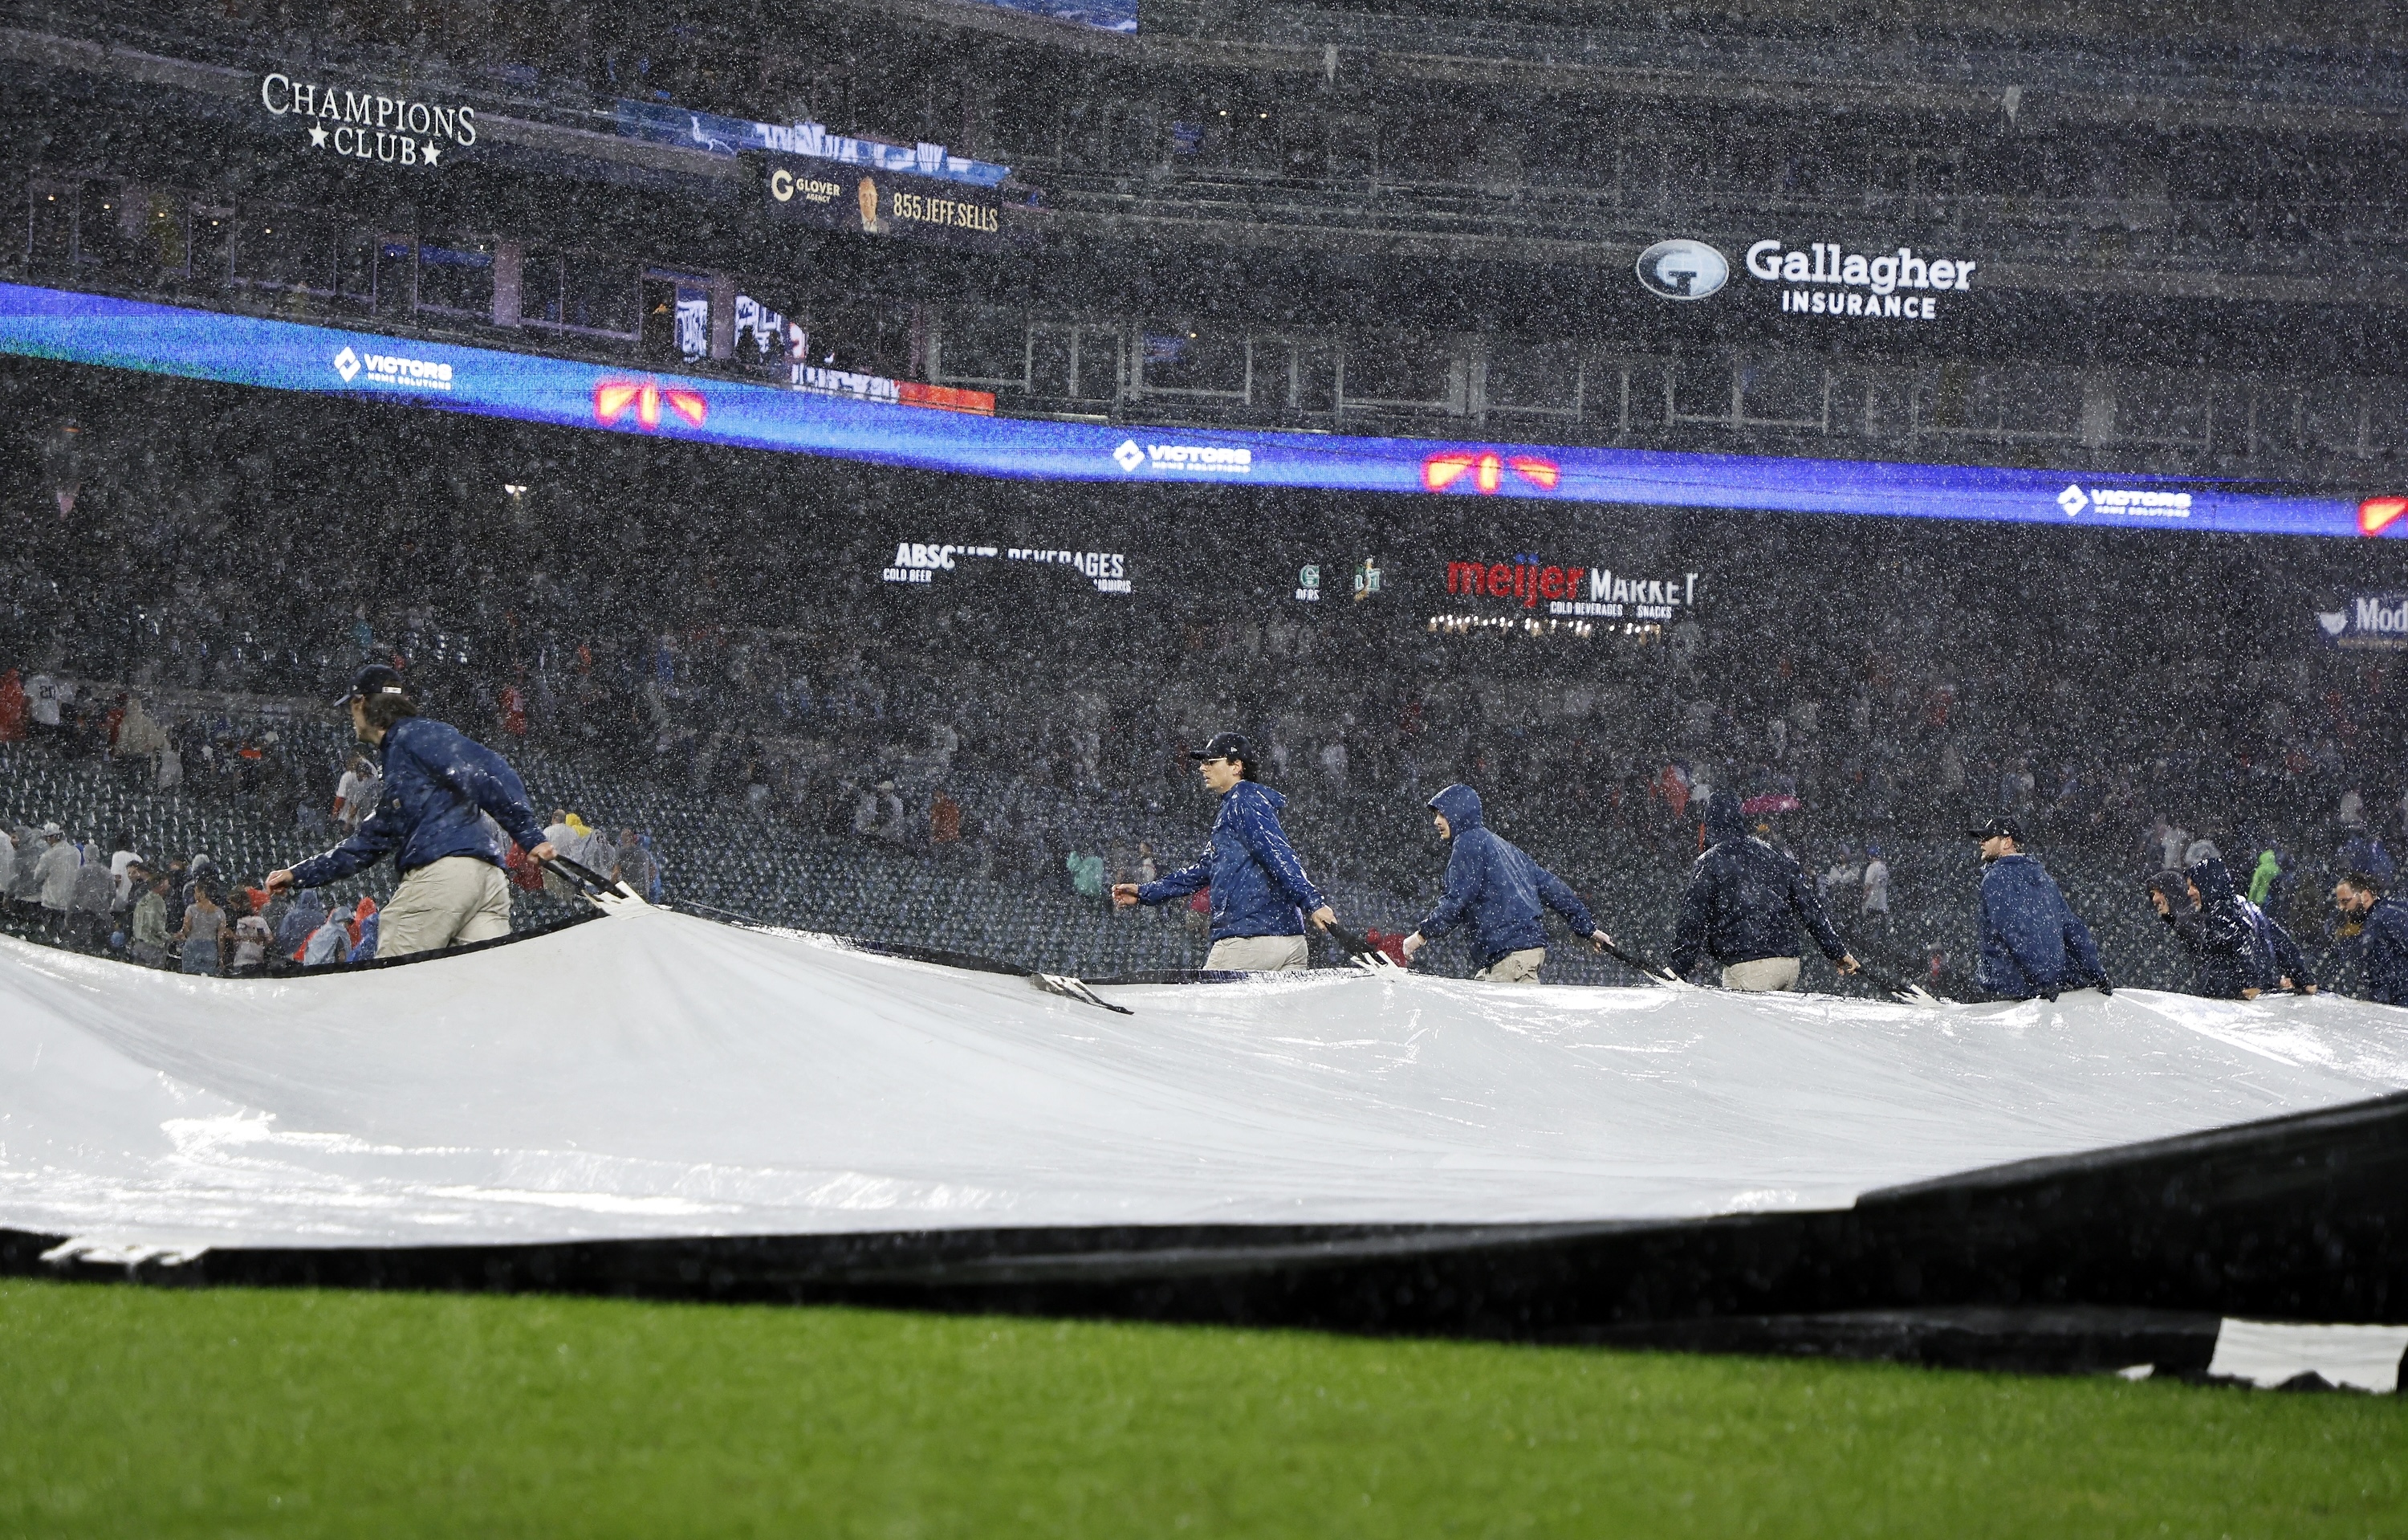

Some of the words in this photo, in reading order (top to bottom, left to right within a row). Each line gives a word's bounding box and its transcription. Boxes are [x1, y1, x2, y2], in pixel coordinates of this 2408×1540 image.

[262, 73, 477, 146] CHAMPIONS
[334, 127, 417, 165] CLUB
[795, 177, 840, 197] GLOVER
[893, 192, 999, 232] 855.JEFF.SELLS
[1746, 239, 1976, 295] Gallagher
[1782, 290, 1936, 320] INSURANCE
[364, 353, 452, 381] VICTORS
[1148, 444, 1251, 464] VICTORS
[2091, 489, 2192, 507] VICTORS
[883, 568, 907, 582] COLD
[909, 569, 932, 583] BEER
[1447, 552, 1585, 608] meijer
[1549, 601, 1573, 615] COLD
[1575, 602, 1624, 617] BEVERAGES
[1636, 605, 1673, 620] SNACKS
